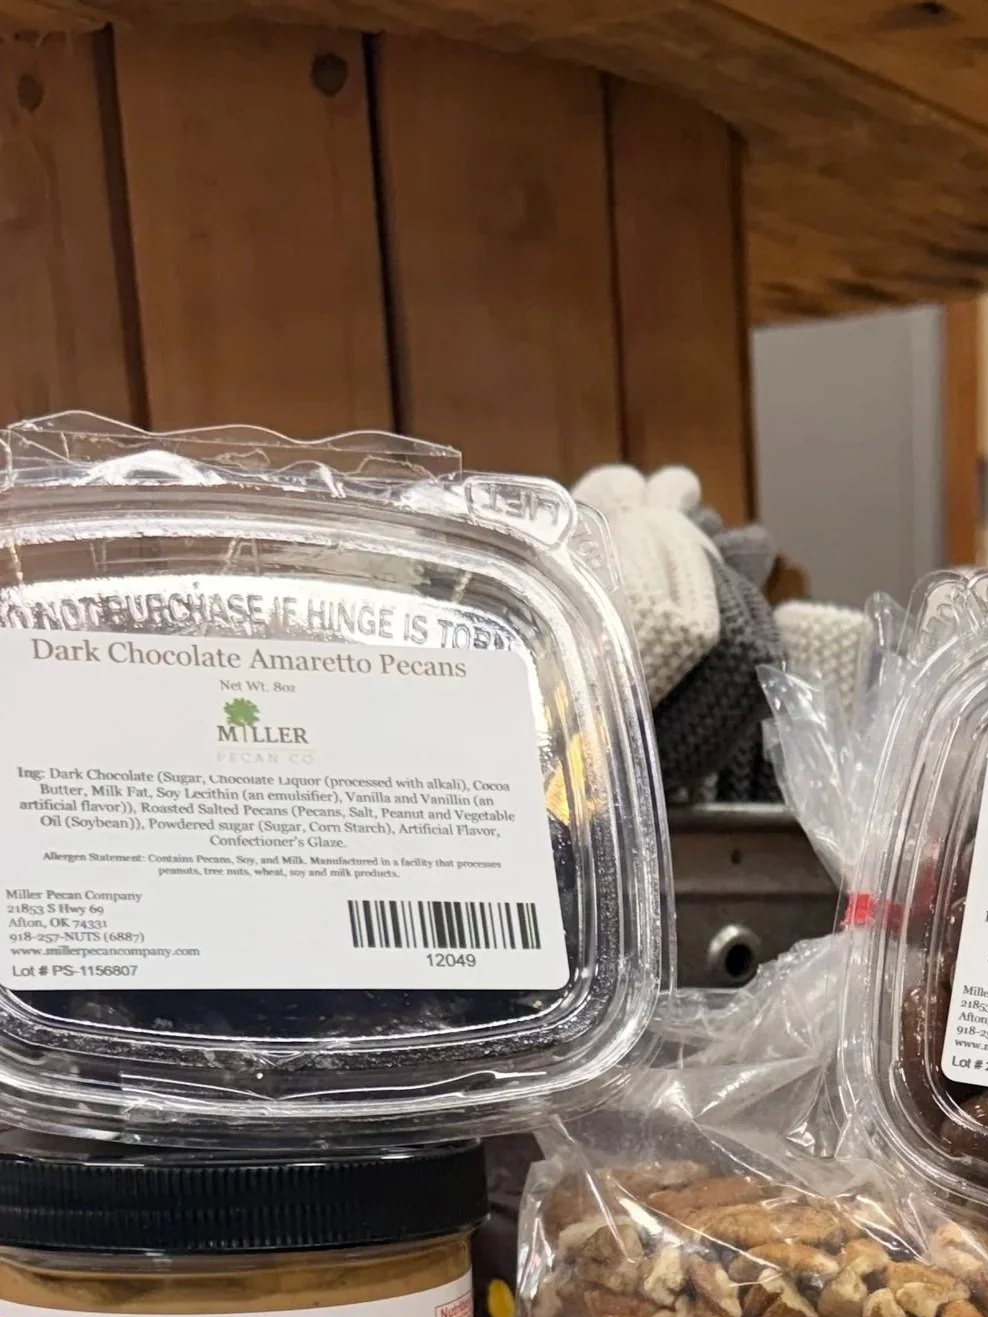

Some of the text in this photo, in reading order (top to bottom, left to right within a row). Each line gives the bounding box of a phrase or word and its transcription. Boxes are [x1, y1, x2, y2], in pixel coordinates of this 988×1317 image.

[307, 598, 395, 639] HINGE
[403, 613, 428, 645] IS
[33, 638, 466, 677] Dark Chocolate Amaretto Pecans
[217, 725, 309, 744] MILLER
[426, 953, 476, 967] 12049
[12, 964, 138, 976] Lot # PS-1156807
[952, 1055, 971, 1068] Lot
[973, 1059, 983, 1069] #
